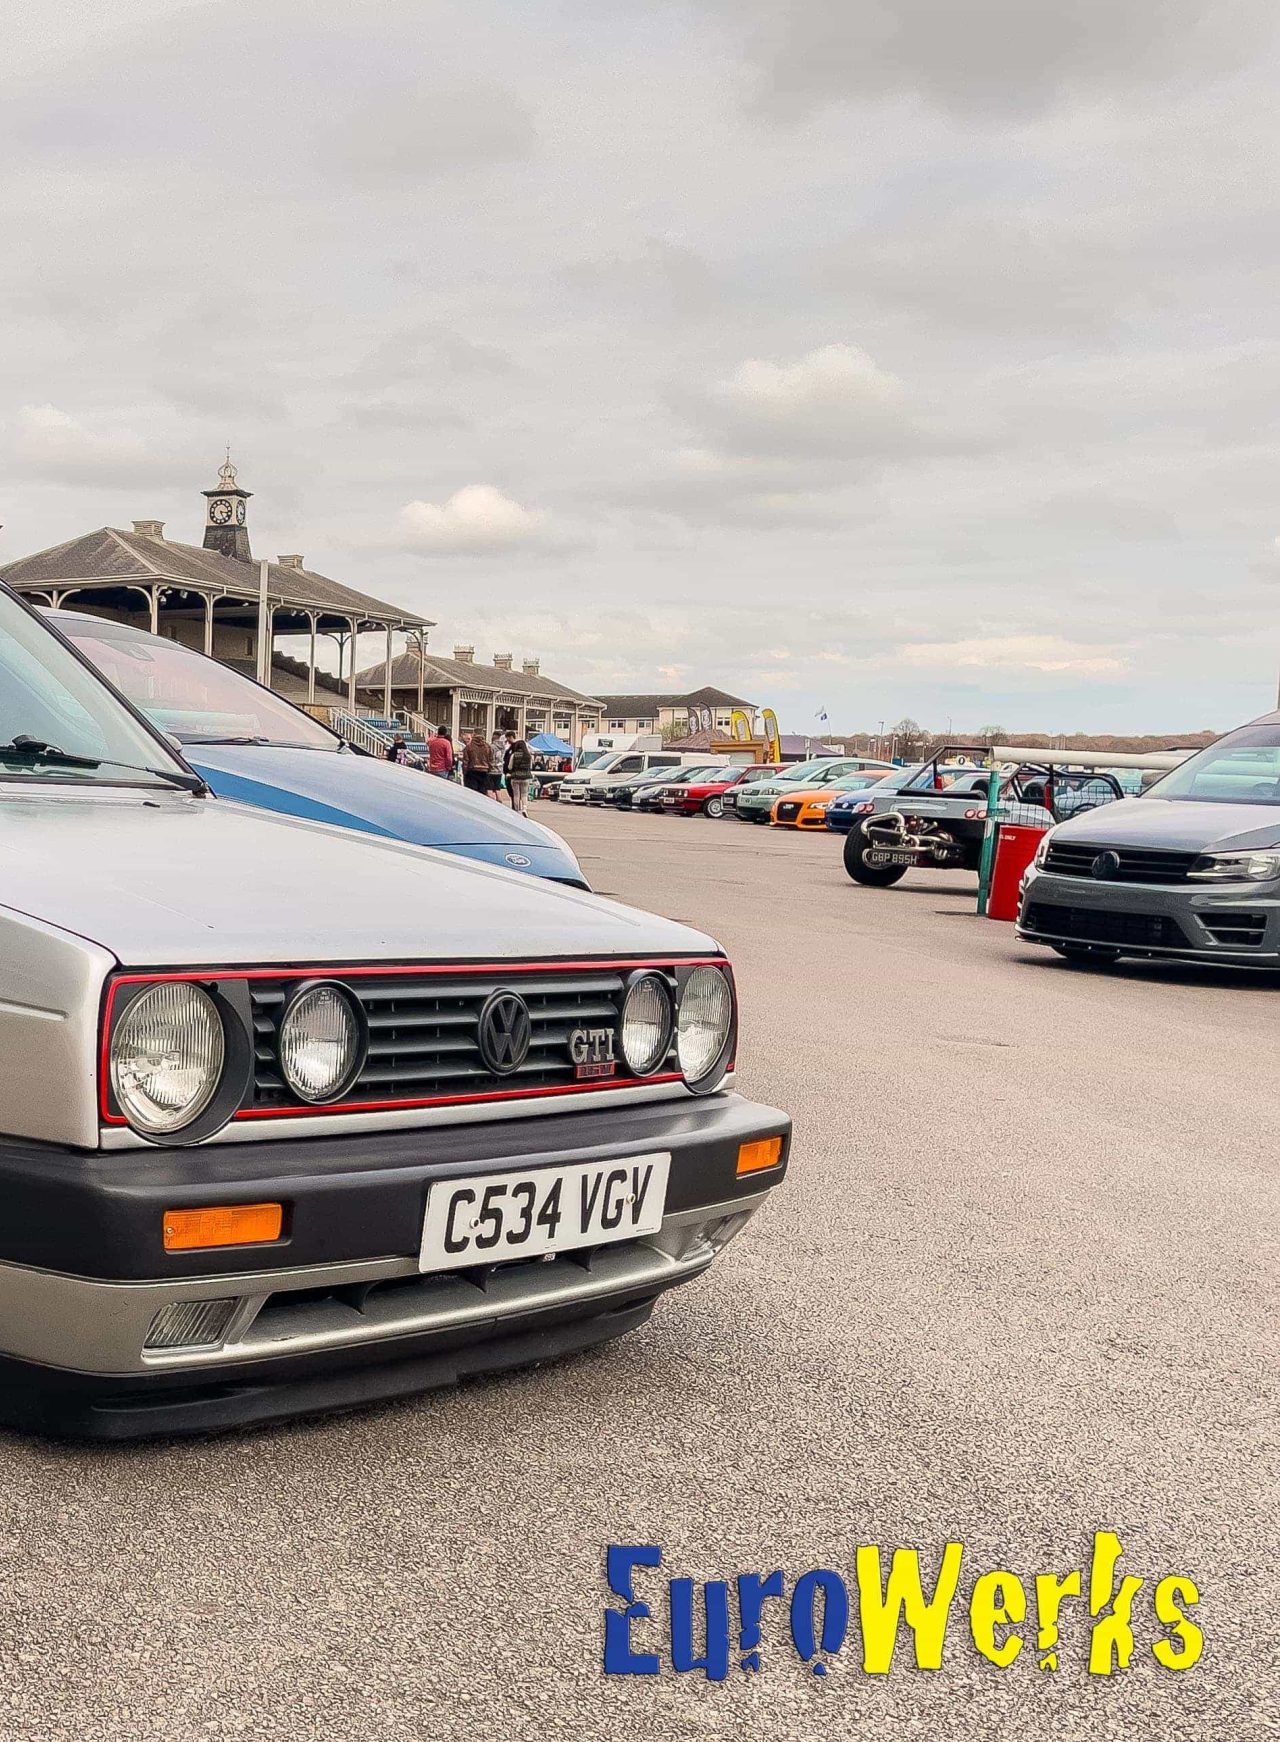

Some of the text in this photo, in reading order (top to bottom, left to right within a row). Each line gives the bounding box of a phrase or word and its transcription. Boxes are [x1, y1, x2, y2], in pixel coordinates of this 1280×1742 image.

[570, 1027, 615, 1064] GTI
[444, 1164, 654, 1254] C534 VGV
